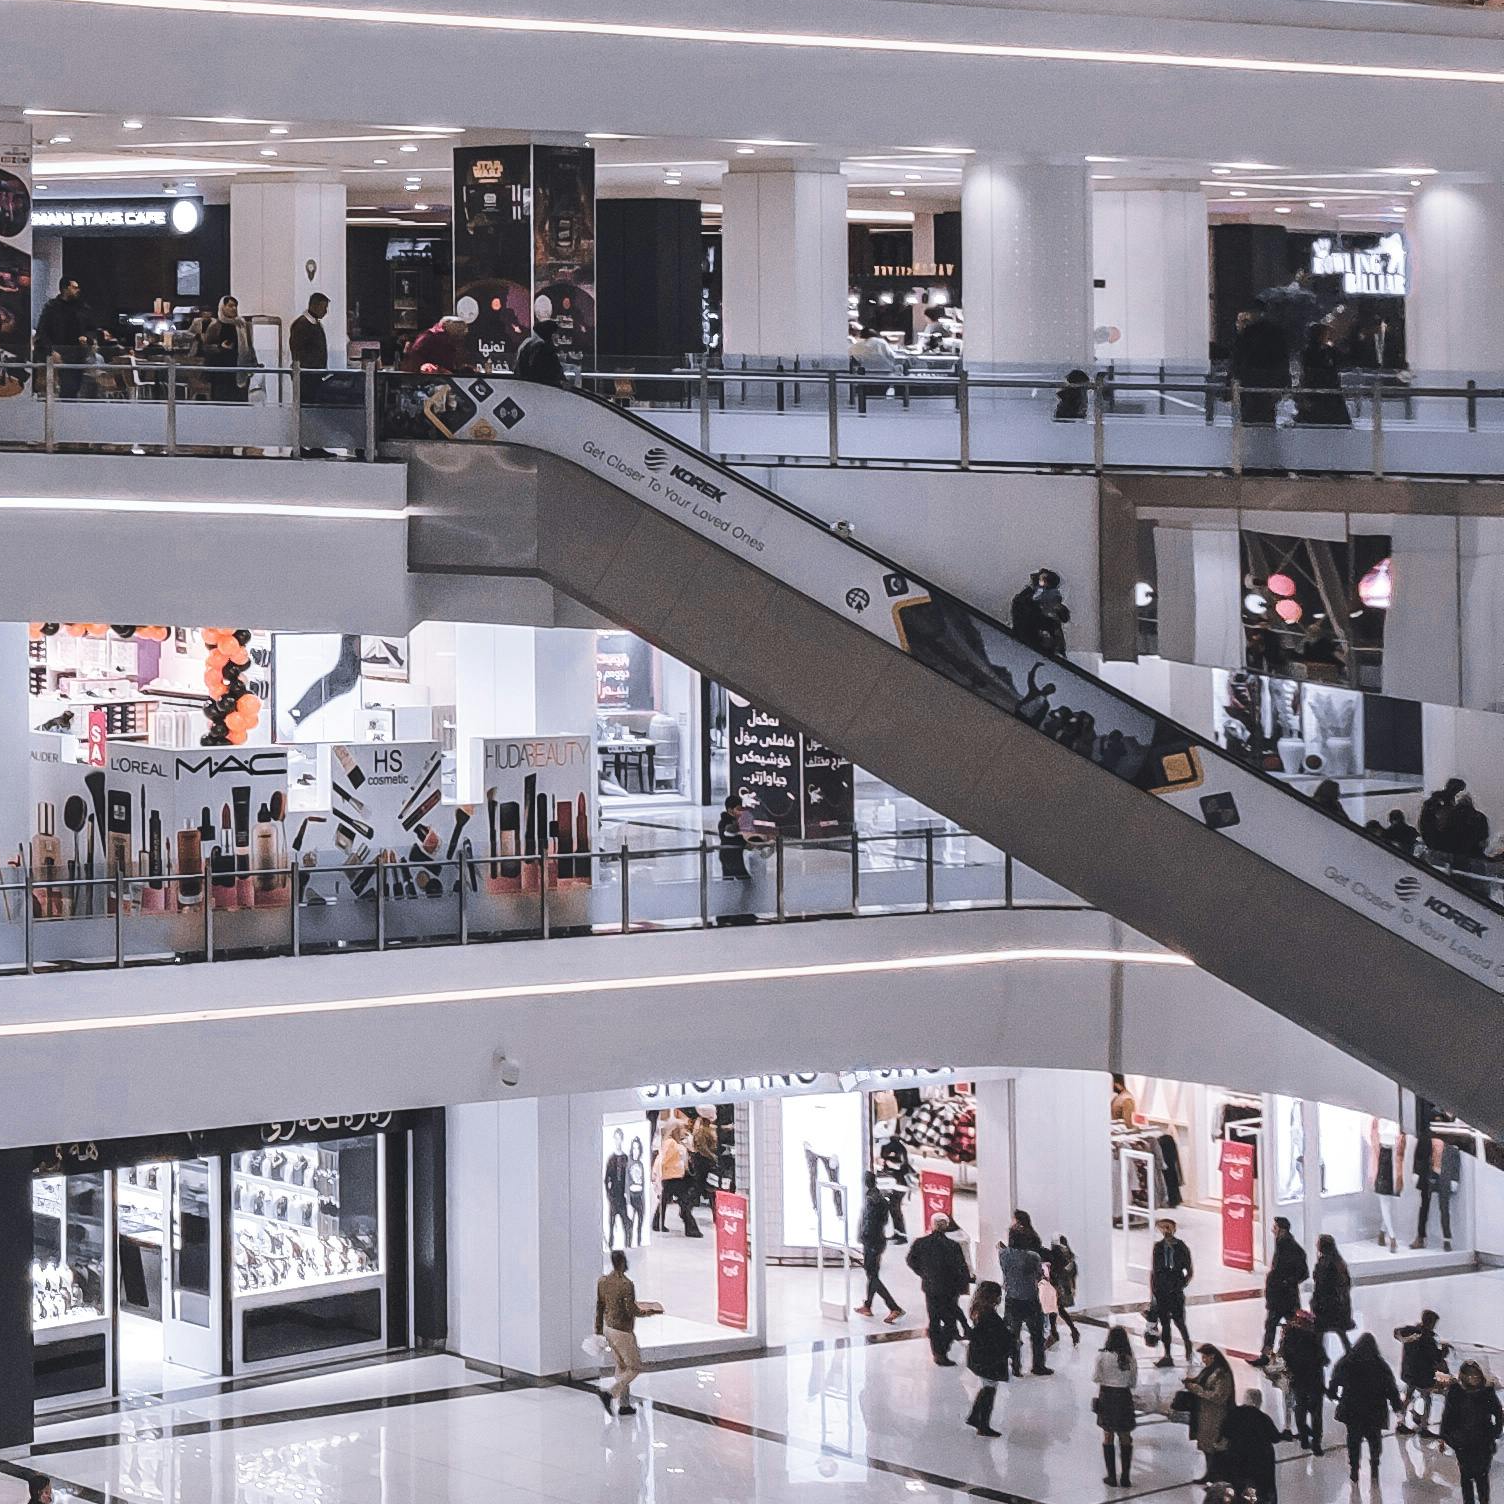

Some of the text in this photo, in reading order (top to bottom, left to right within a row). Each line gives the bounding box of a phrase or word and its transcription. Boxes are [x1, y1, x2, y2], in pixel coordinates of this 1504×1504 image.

[73, 211, 124, 225] STARS
[125, 211, 167, 225] CAFE
[670, 464, 728, 503] KOREK
[582, 441, 765, 552] Get Closer To Your Loved Ones
[374, 749, 403, 772] HS
[367, 774, 409, 786] cosmetic
[1400, 906, 1414, 924] To
[1424, 896, 1489, 938] KOREK
